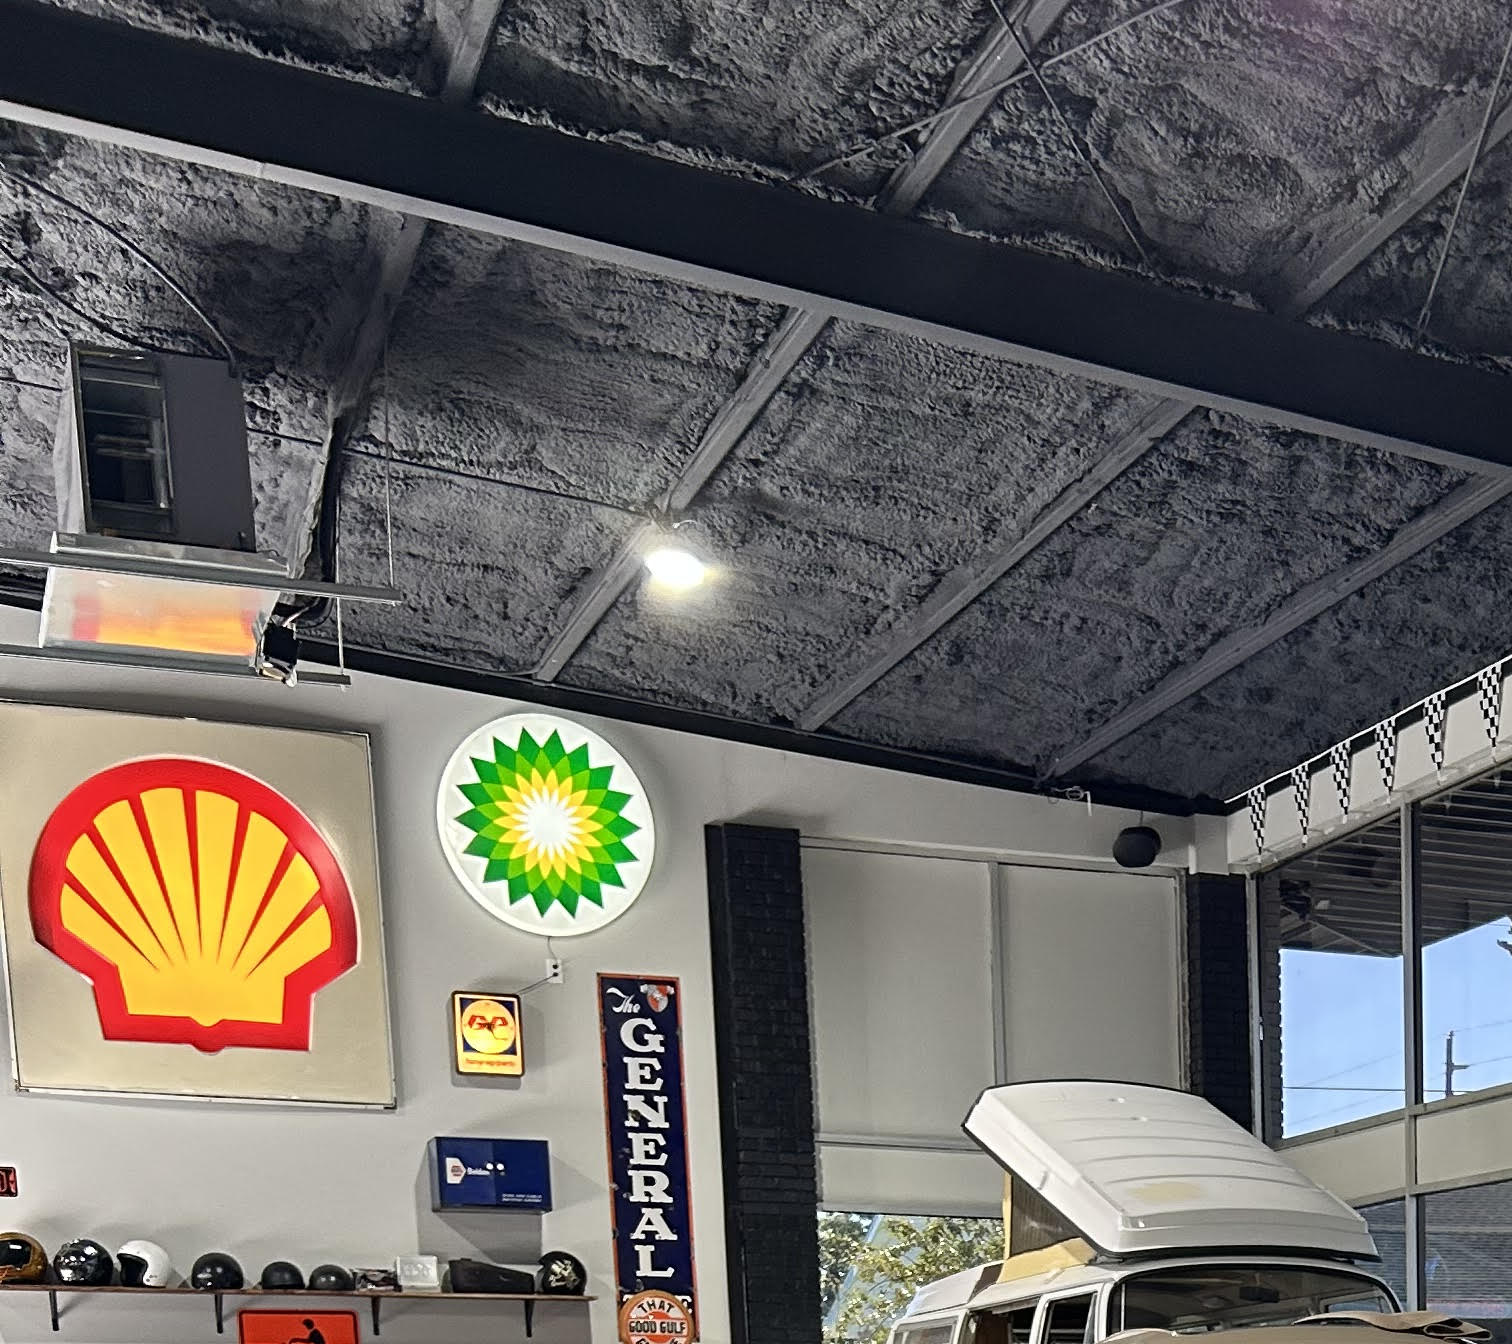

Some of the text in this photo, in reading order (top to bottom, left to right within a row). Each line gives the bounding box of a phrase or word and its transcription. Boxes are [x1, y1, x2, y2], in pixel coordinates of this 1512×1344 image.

[606, 987, 641, 1013] The
[620, 1017, 678, 1278] GENERAL
[637, 1300, 675, 1313] THAT
[629, 1320, 686, 1334] GOOD GULF
